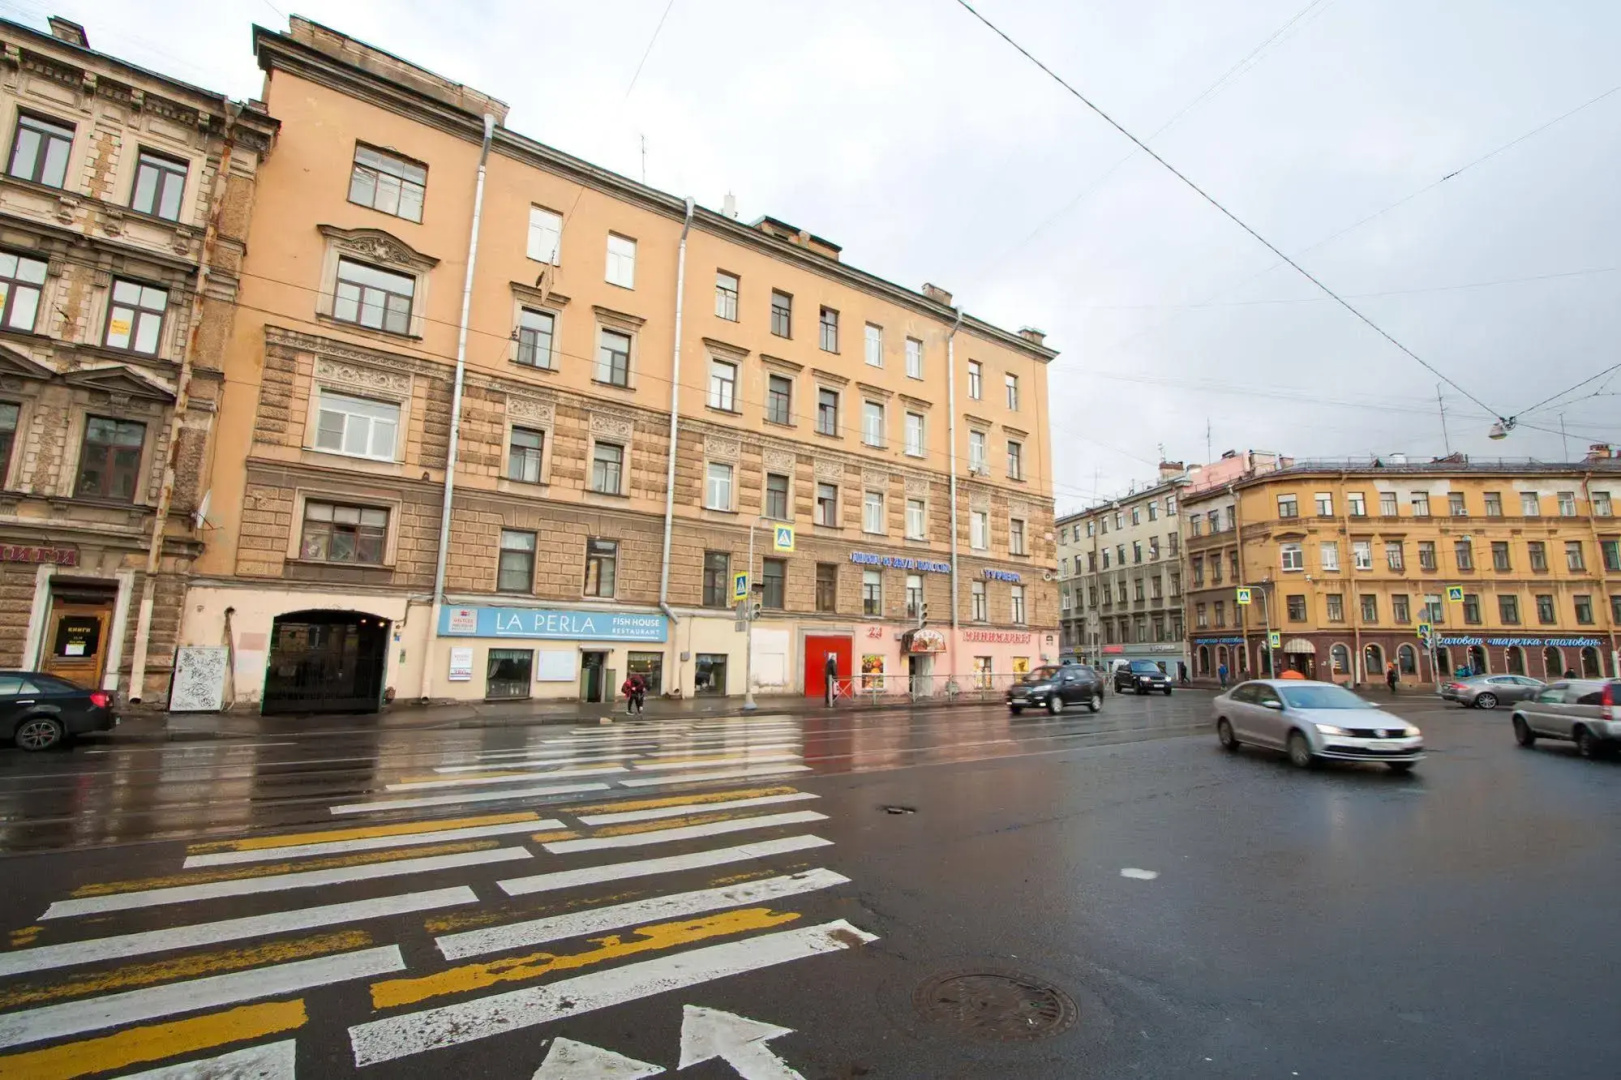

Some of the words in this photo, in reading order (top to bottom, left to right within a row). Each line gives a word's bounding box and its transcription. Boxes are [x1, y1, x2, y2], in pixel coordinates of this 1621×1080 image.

[496, 612, 523, 631] LA
[534, 613, 596, 633] PERLA
[612, 617, 631, 626] FISH
[632, 618, 660, 627] HOUSE
[612, 627, 660, 635] RESTAURANT
[964, 630, 1032, 645] МИНИМАРКЕТ
